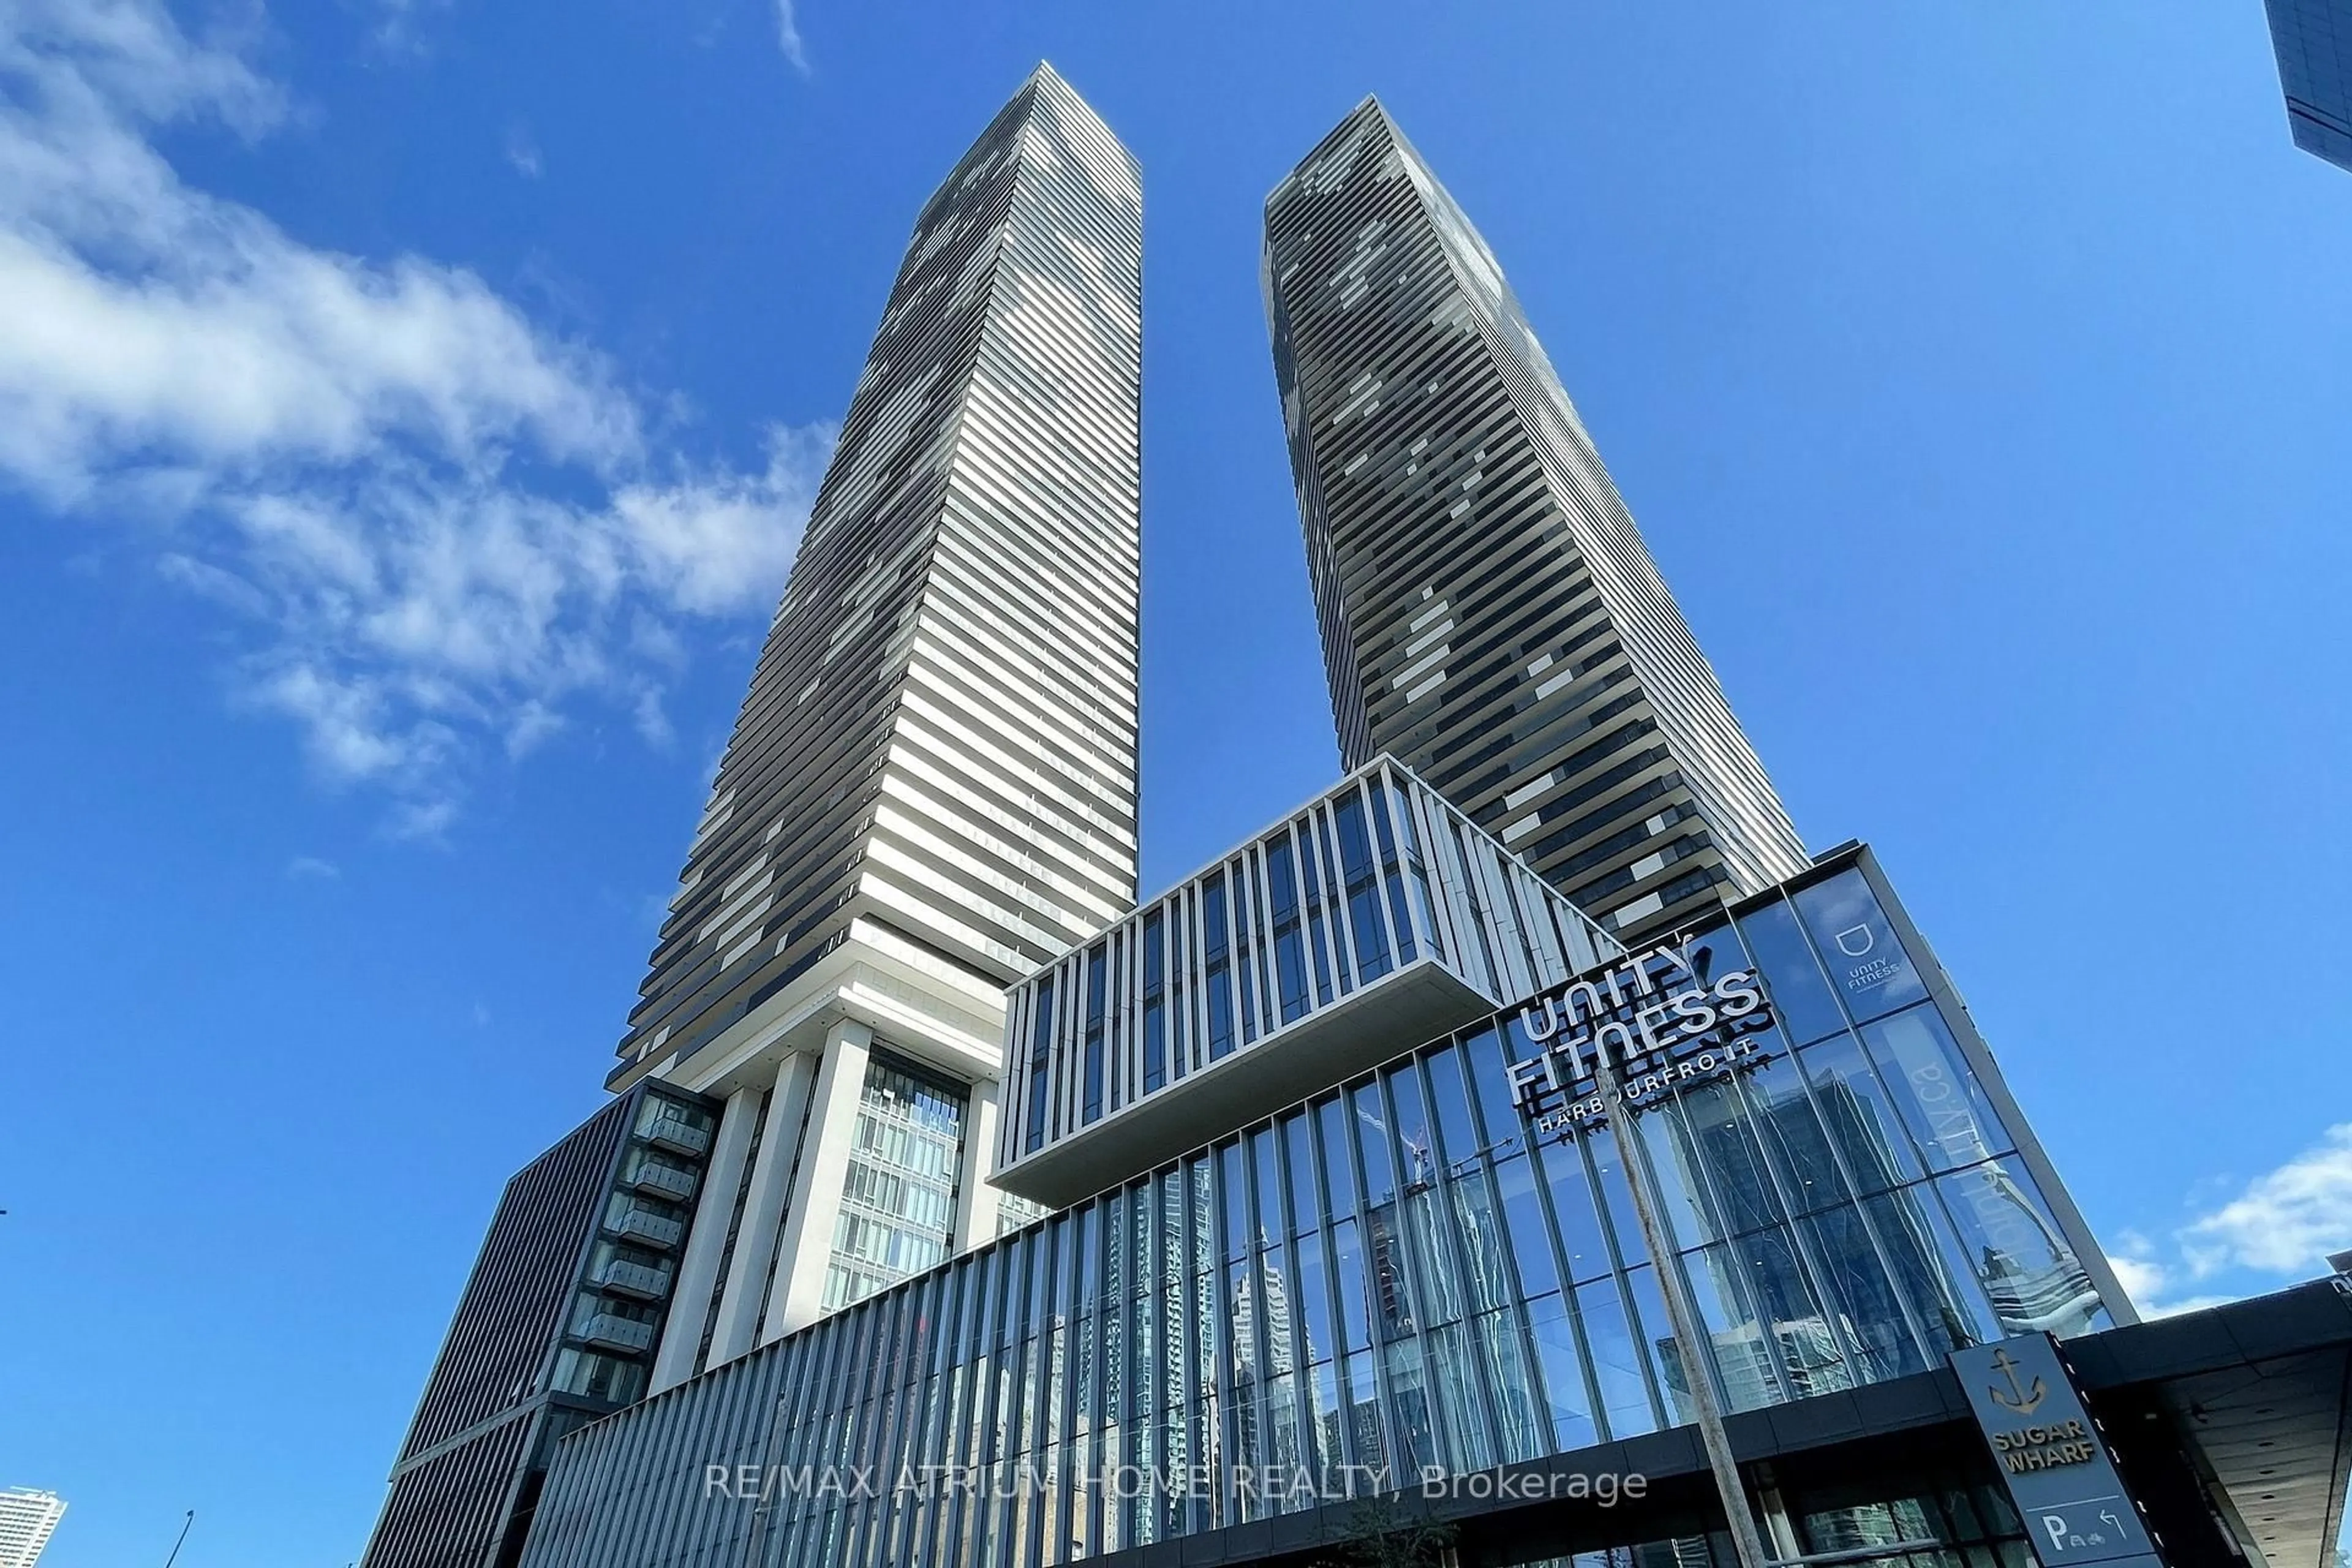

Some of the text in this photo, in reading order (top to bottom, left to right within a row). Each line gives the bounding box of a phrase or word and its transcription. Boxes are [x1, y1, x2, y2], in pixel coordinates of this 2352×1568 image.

[1848, 963, 1900, 989] FITNESS
[1849, 956, 1886, 978] UNITY
[1521, 934, 1694, 1041] UNITY
[1507, 971, 1760, 1105] FITNESS
[1993, 1419, 2085, 1451] SUGAR
[2001, 1441, 2093, 1472] WHARF
[2042, 1515, 2067, 1550] P
